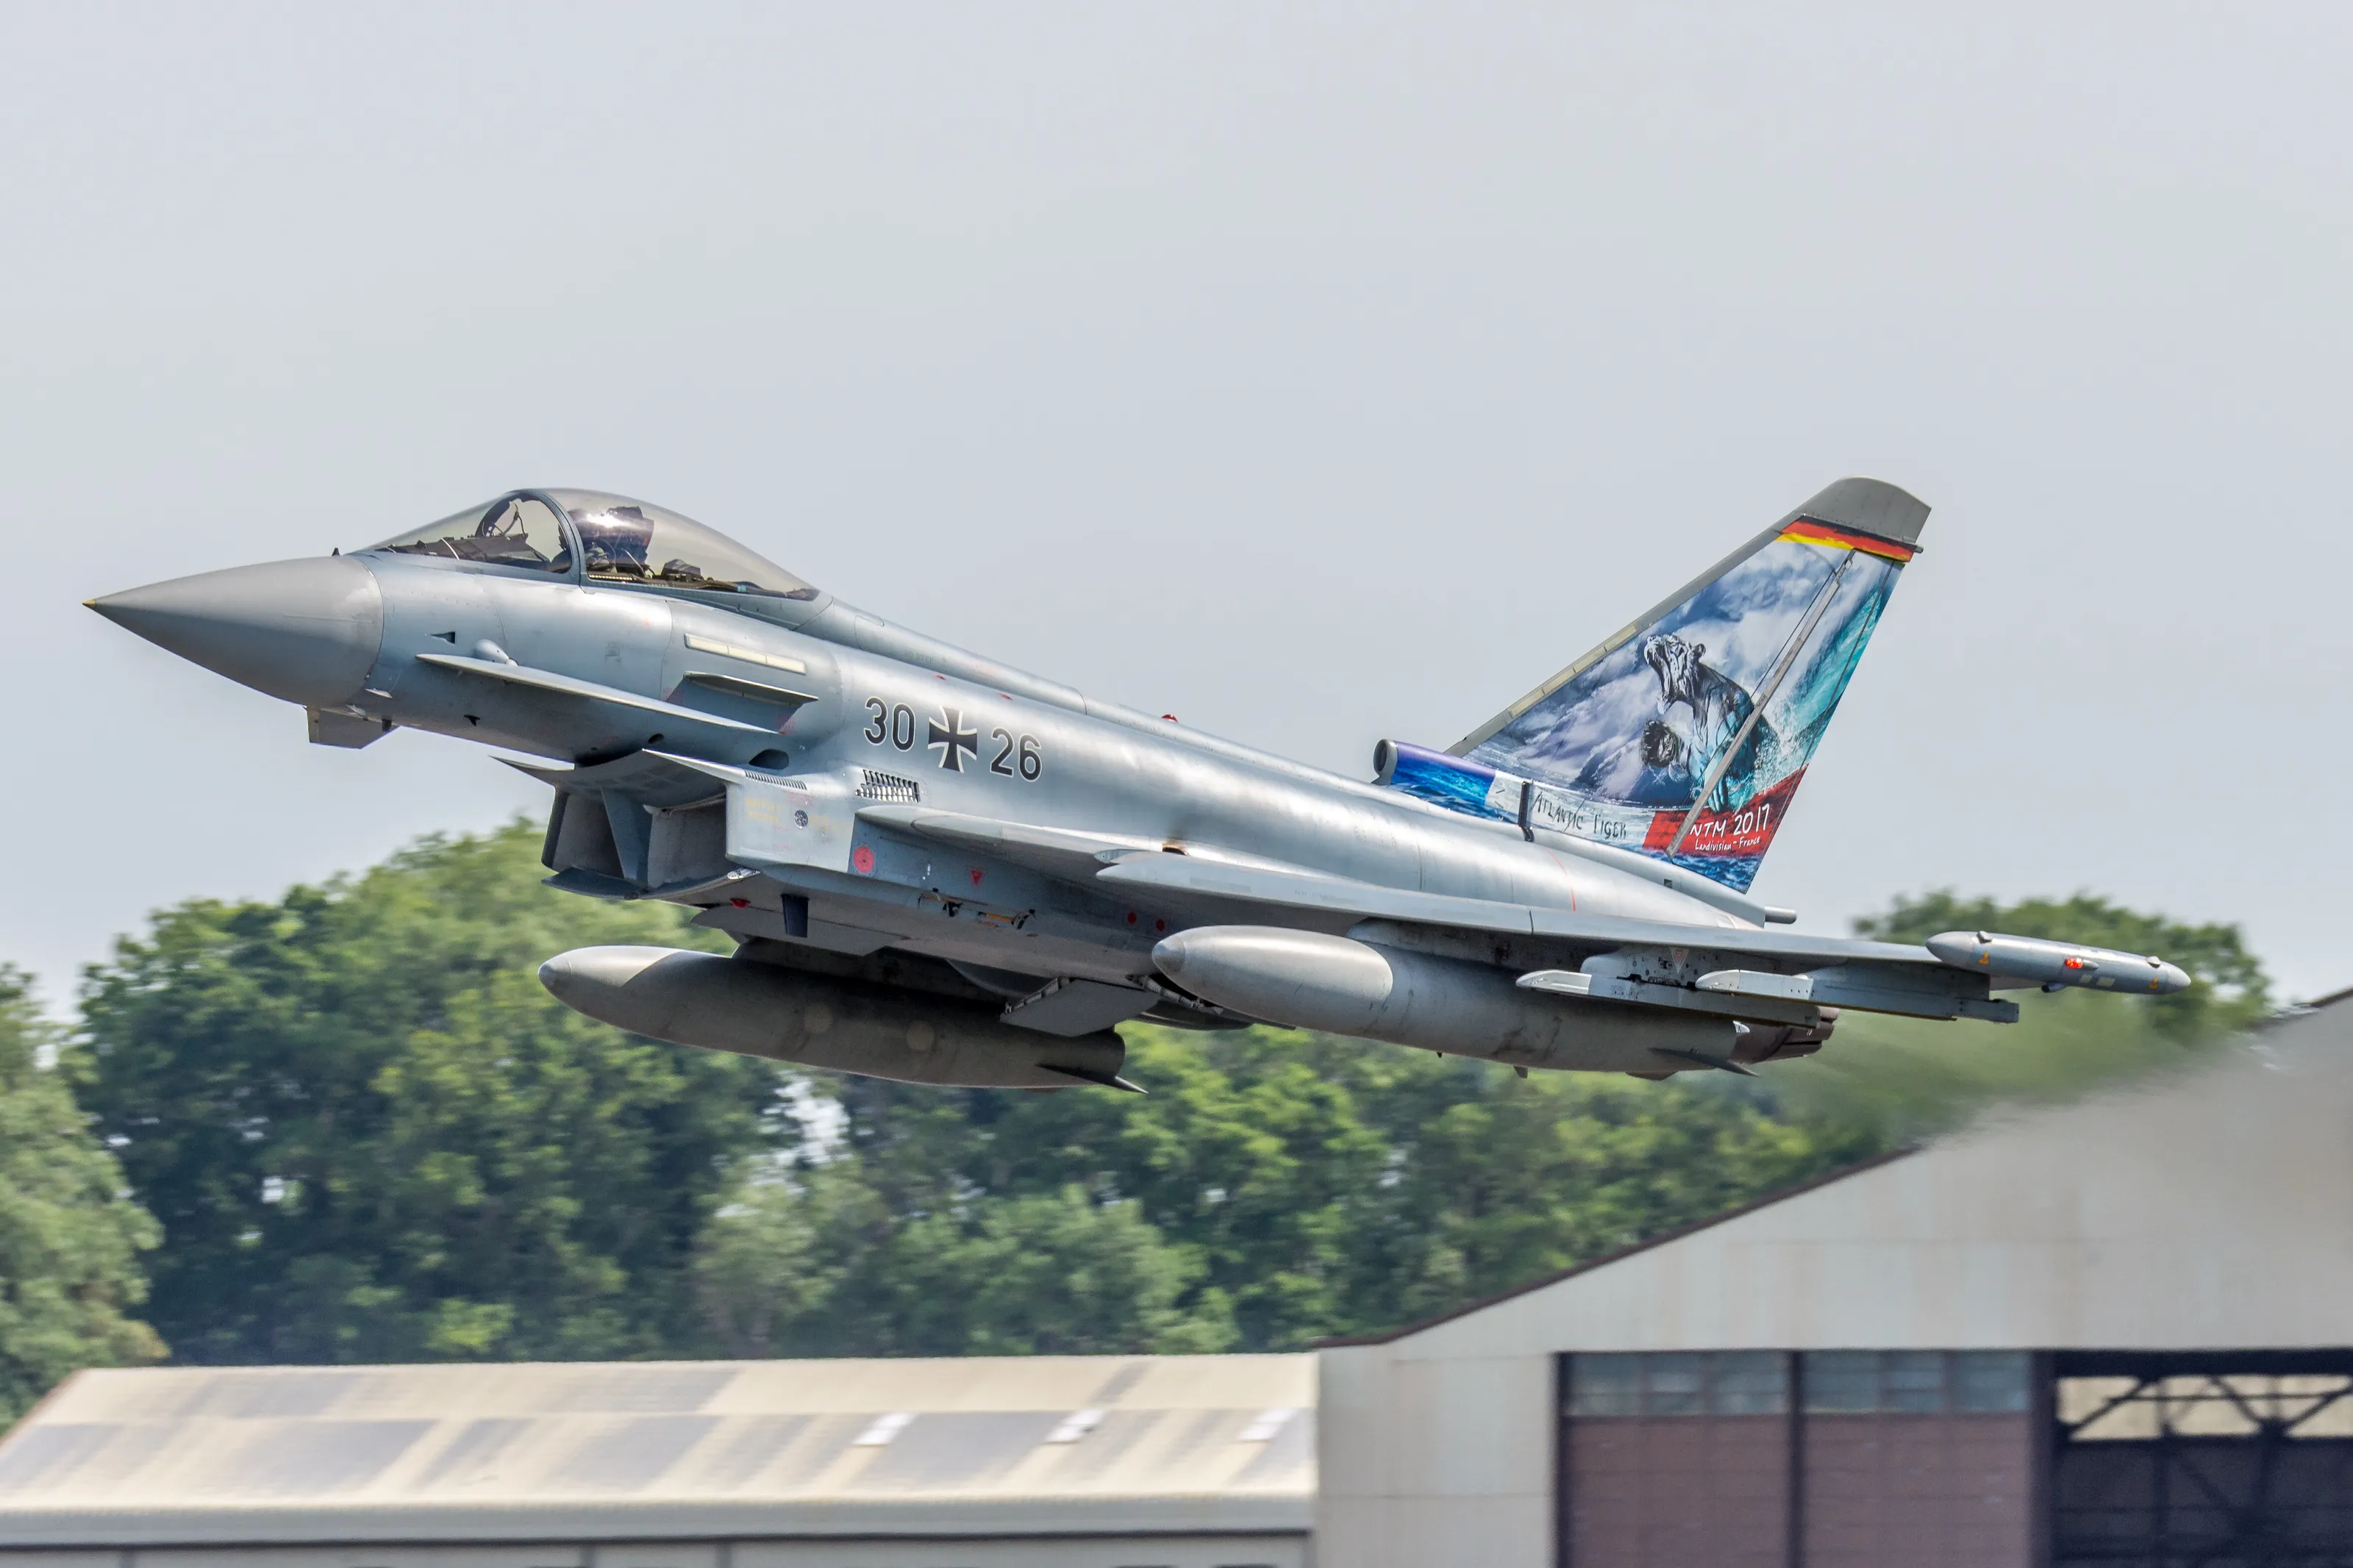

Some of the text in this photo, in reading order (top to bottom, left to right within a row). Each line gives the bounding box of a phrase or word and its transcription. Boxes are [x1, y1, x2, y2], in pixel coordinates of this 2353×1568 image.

[863, 695, 1042, 782] 30 26
[1532, 791, 1627, 840] ATLANTIC TIGER
[1690, 803, 1770, 838] NTM 2017
[1738, 835, 1761, 848] France
